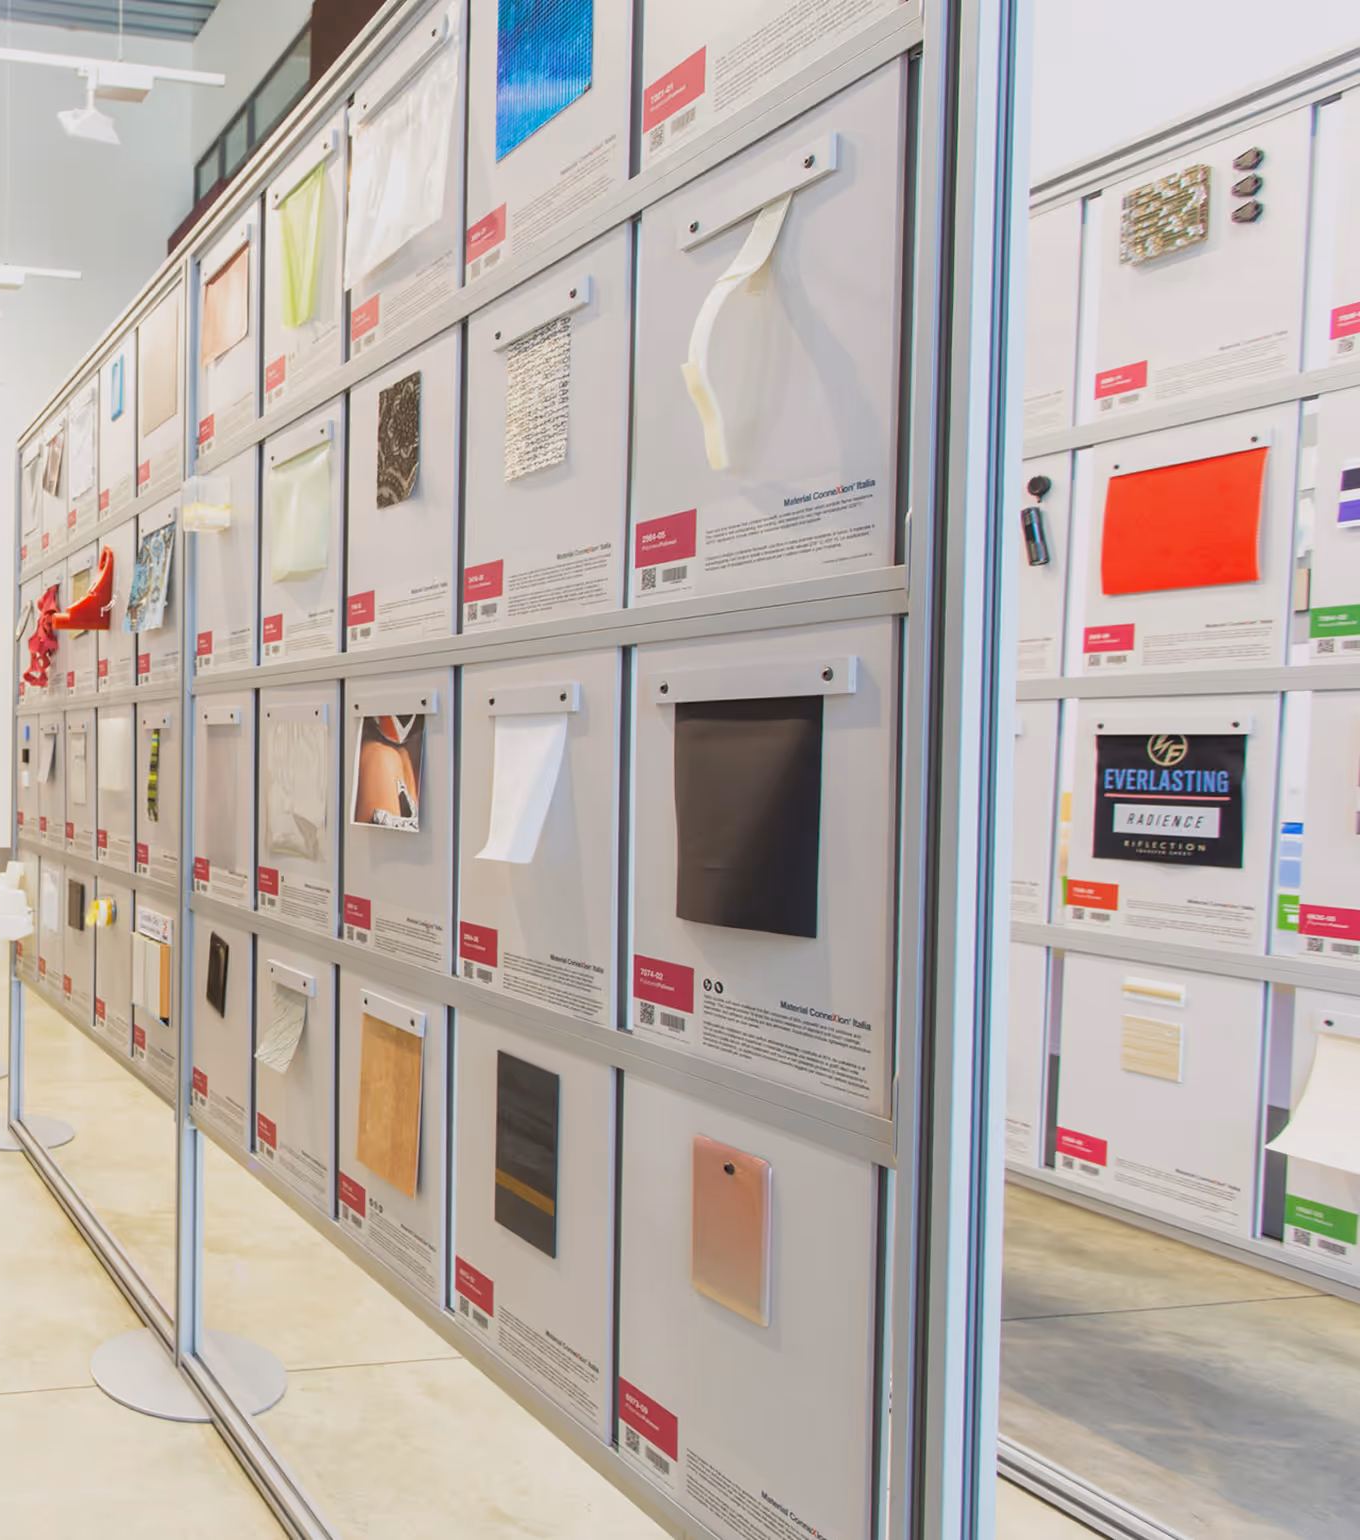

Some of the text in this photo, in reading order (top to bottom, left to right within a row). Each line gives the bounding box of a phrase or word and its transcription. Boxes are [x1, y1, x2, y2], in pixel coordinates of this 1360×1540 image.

[783, 493, 811, 507] Material
[856, 479, 876, 490] Italia
[1104, 768, 1230, 793] EVERLASTING
[1126, 813, 1204, 829] RADIENCE
[780, 1000, 808, 1015] Material
[852, 1018, 871, 1031] Italia
[761, 1490, 789, 1516] Material
